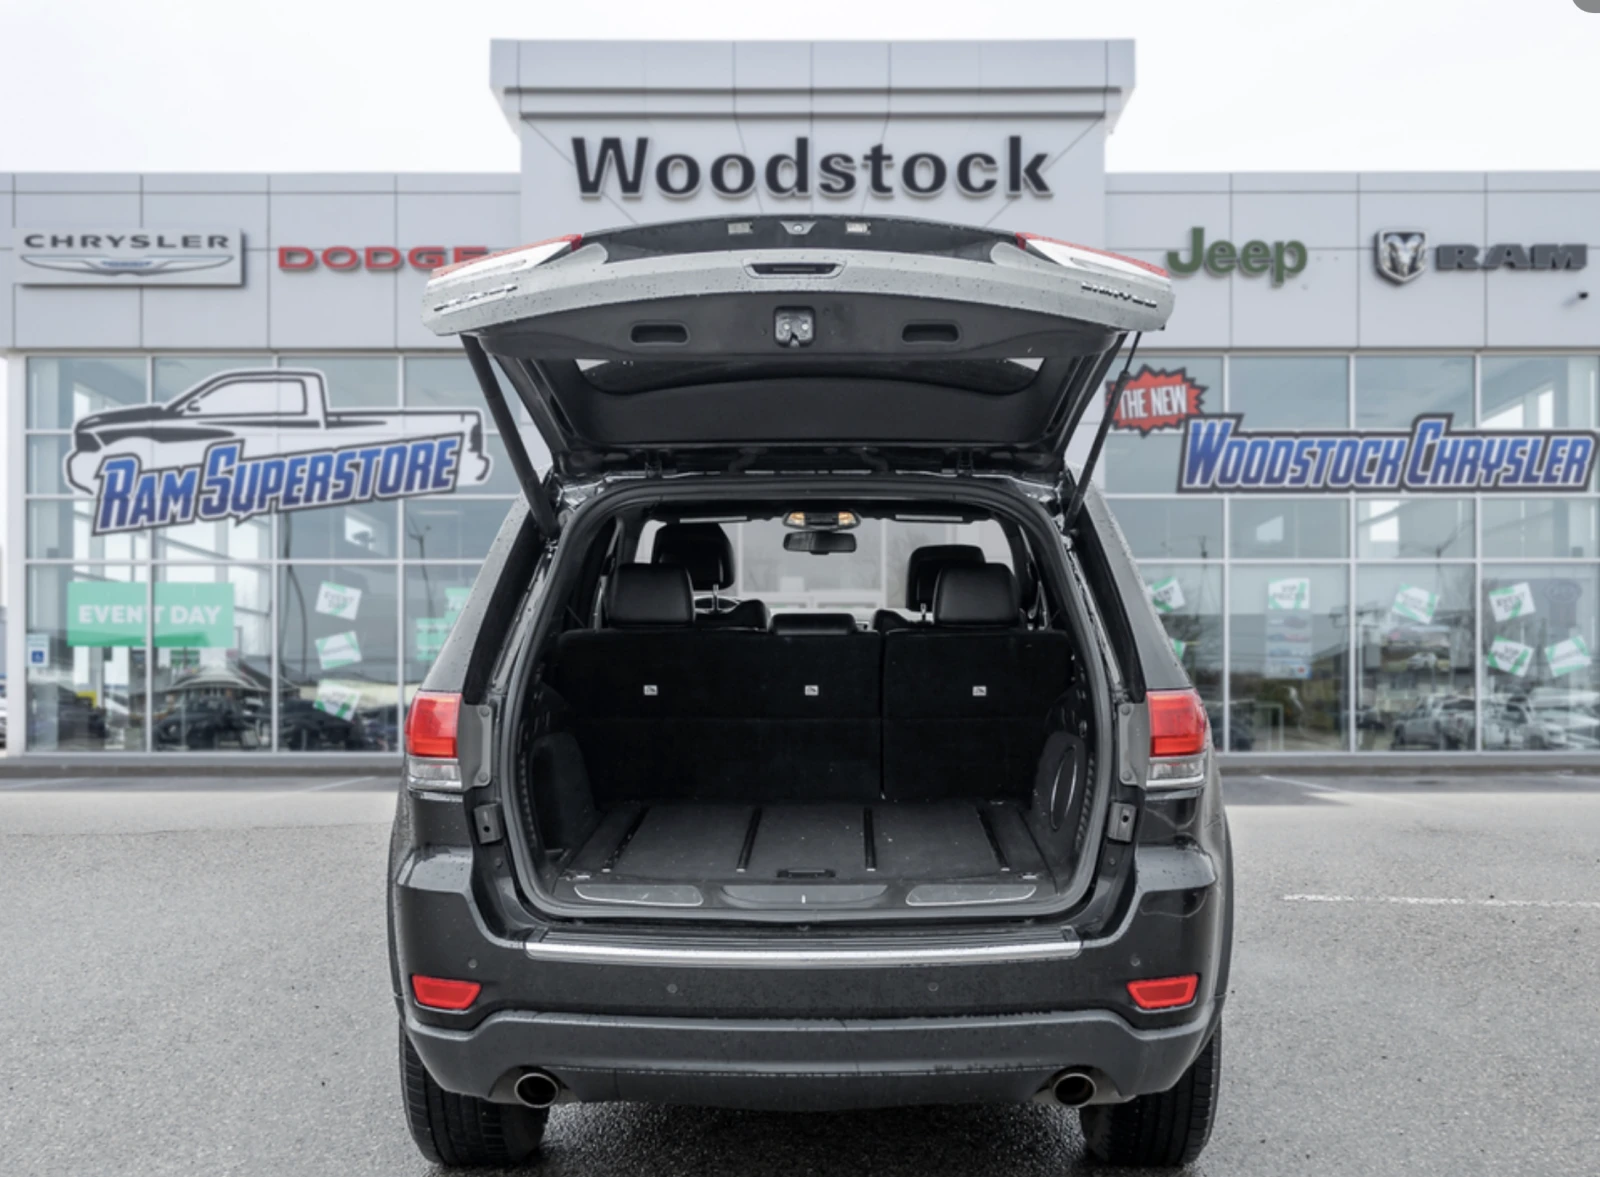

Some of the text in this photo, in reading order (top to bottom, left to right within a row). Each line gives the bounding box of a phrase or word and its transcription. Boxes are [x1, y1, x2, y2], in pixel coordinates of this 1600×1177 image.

[570, 135, 1053, 200] Woodstock
[23, 233, 231, 250] CHRYSLER
[1166, 227, 1308, 286] Jeep
[1435, 243, 1588, 271] RAM
[1120, 383, 1188, 420] THE NEW
[1182, 417, 1595, 489] WOODSTOCK CHRYSLER
[97, 436, 460, 532] RAM SUPERSTORE
[78, 604, 222, 625] EVENT DAY
